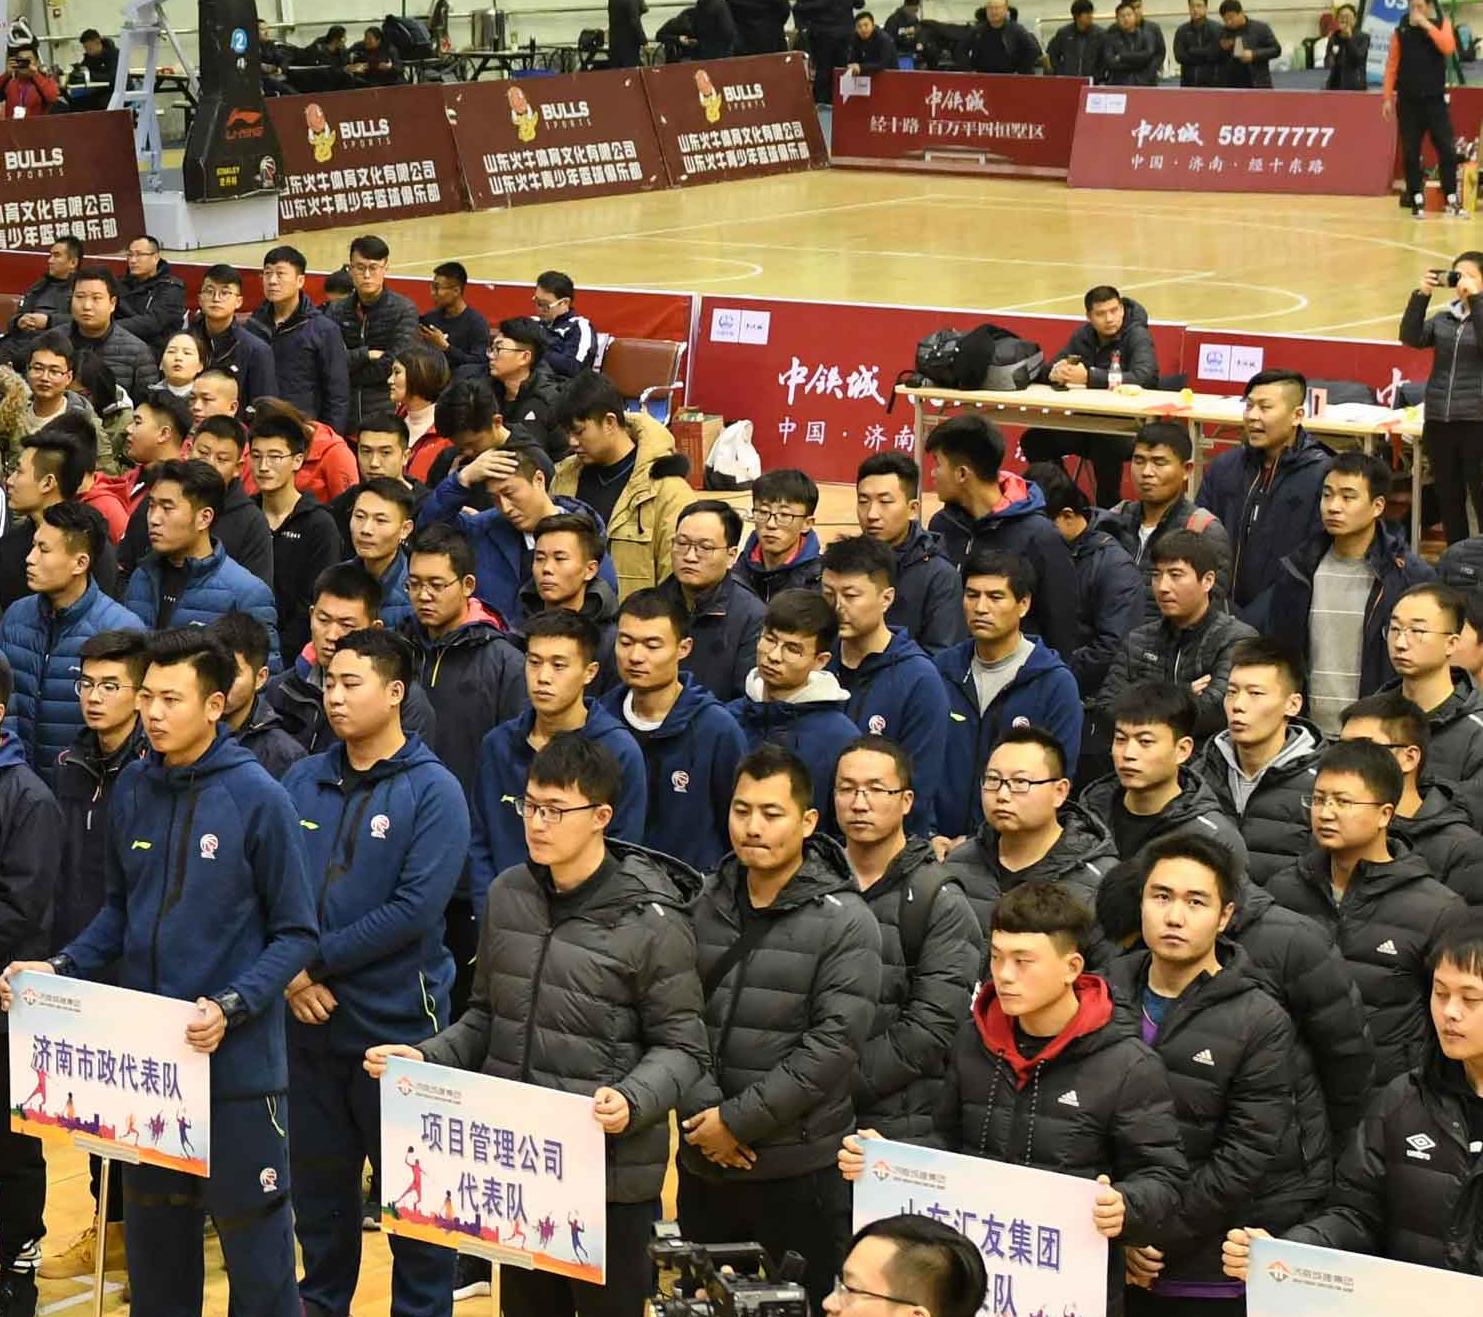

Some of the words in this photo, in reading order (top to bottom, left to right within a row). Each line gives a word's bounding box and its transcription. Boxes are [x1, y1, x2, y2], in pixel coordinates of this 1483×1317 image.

[723, 83, 764, 102] BULLS
[541, 101, 589, 120] BULLS
[339, 118, 391, 139] BULLS
[1217, 124, 1335, 148] 58777777
[4, 148, 64, 170] BULLS
[6, 168, 65, 182] SPORTS
[777, 418, 914, 454] 中国·济南
[32, 1035, 183, 1100] 济南市政代表队
[421, 1112, 563, 1180] 项目管理公司
[457, 1172, 528, 1223] 代表队
